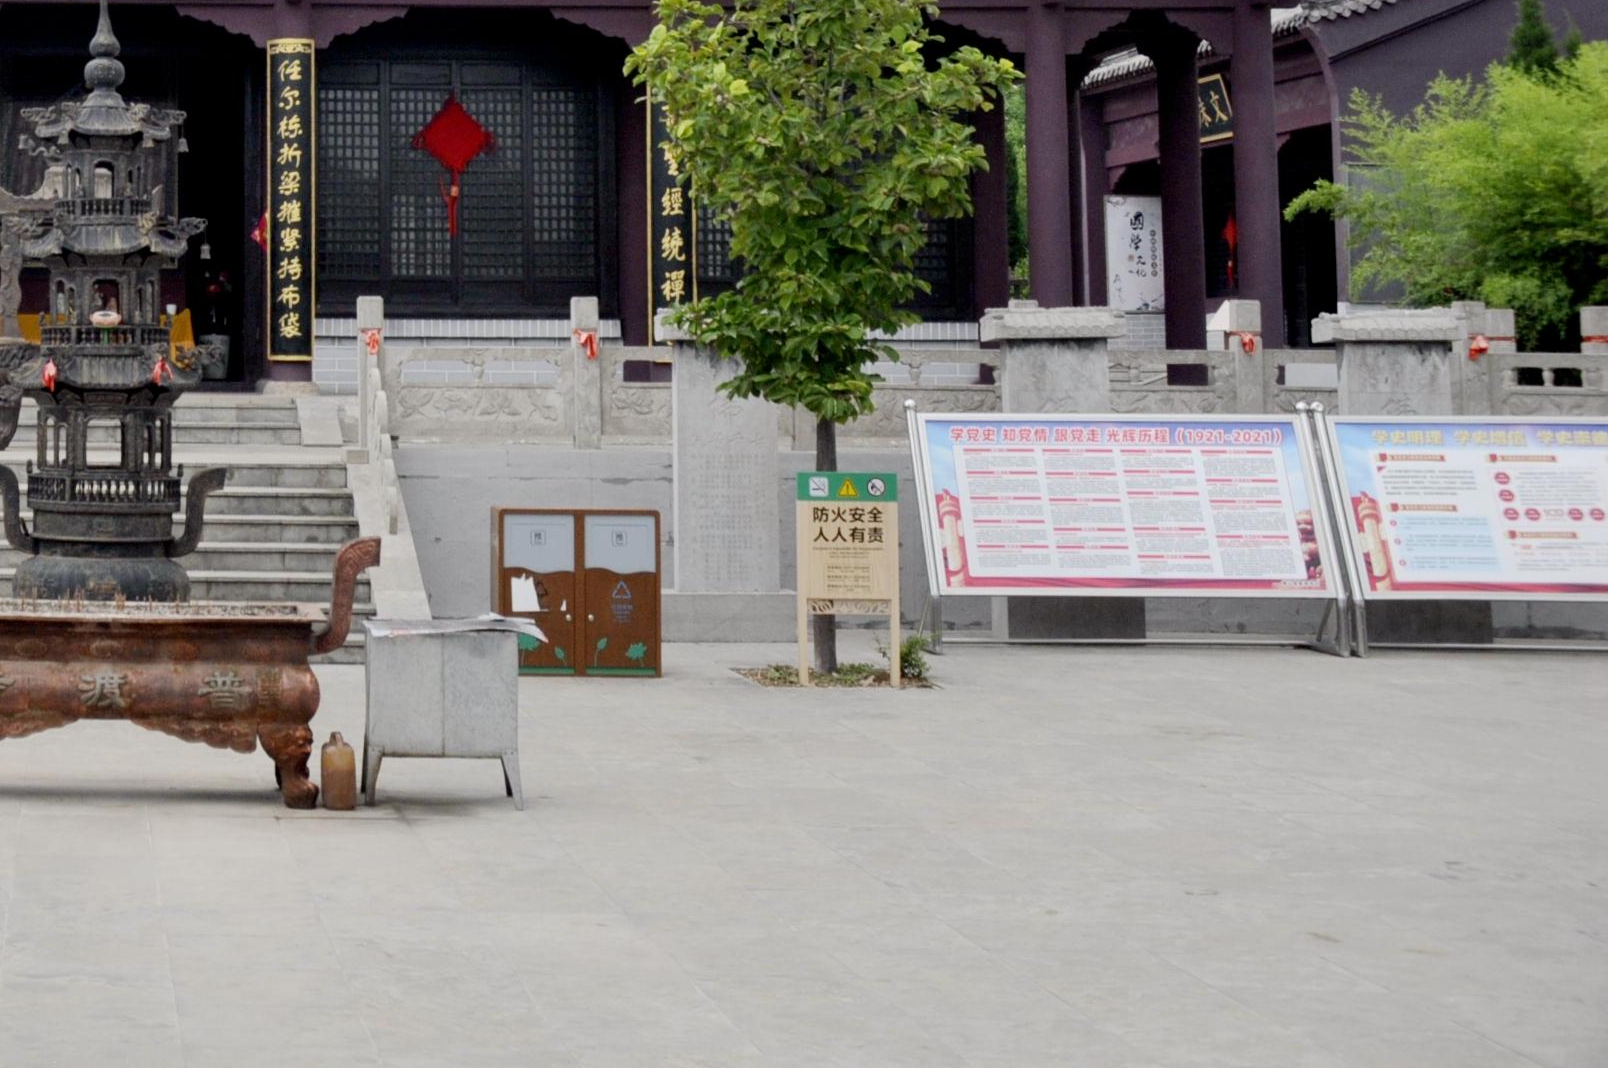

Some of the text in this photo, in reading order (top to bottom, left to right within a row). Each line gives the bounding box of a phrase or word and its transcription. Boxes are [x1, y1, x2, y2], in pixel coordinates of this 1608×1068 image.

[950, 427, 997, 442] 学党史
[1002, 427, 1049, 442] 知党情
[1054, 428, 1101, 443] 跟党走
[812, 506, 884, 524] 防火安全
[813, 526, 885, 544] 人人有责
